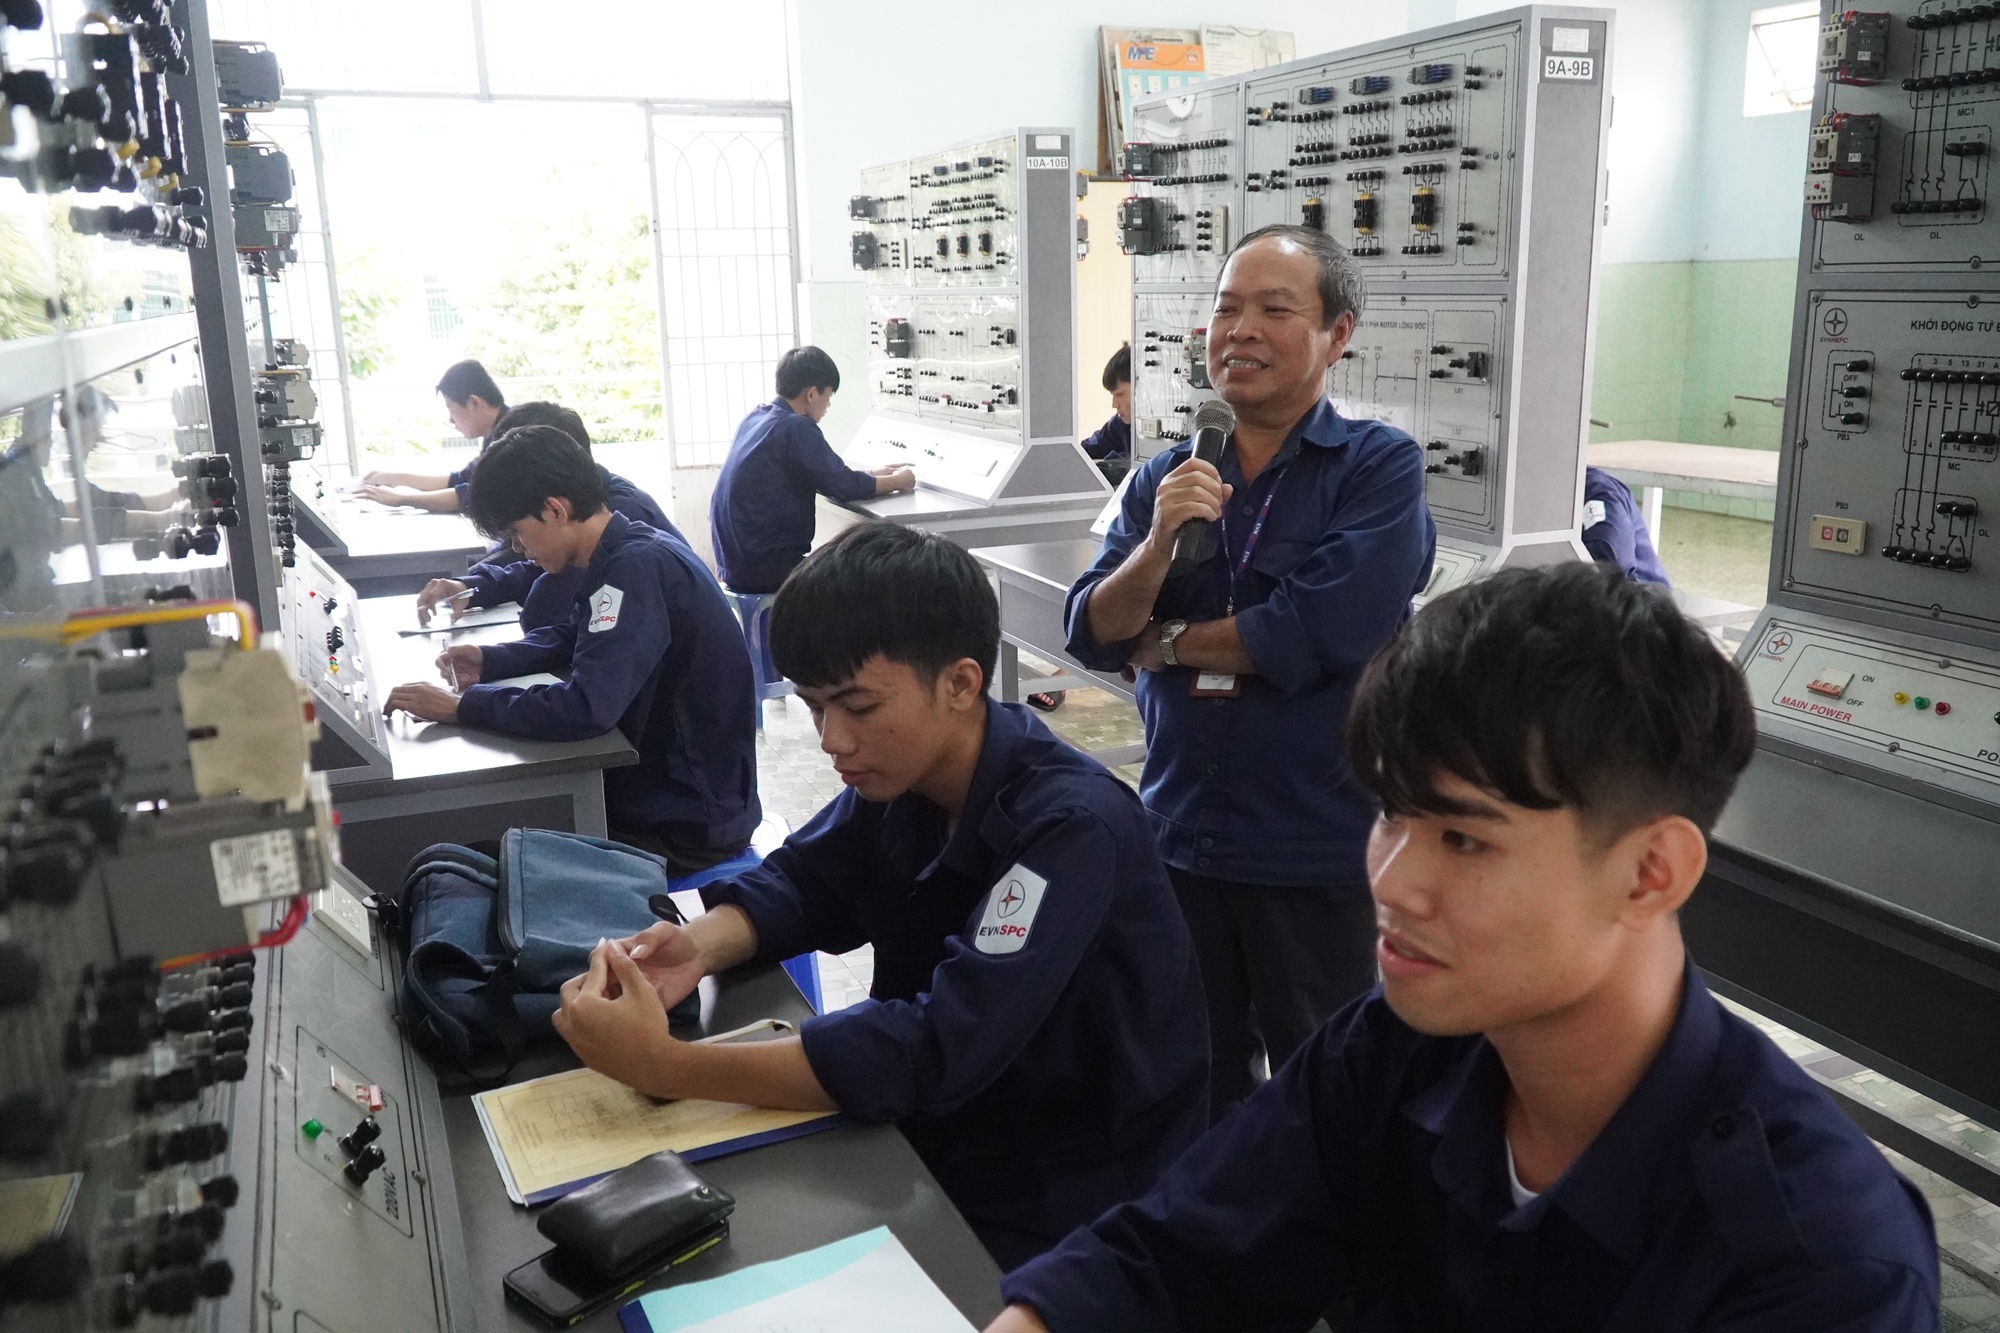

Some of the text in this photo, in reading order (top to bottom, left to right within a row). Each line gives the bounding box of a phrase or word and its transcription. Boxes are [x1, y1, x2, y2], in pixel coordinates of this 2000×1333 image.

[1547, 59, 1591, 76] 9A-9B
[1956, 107, 1975, 117] MC1
[1027, 158, 1068, 168] 10A-10B
[1854, 233, 1865, 241] OL
[1929, 231, 1942, 240] OL
[1843, 374, 1858, 382] OFF
[1844, 400, 1854, 408] ON
[1947, 462, 1961, 471] MC
[1835, 501, 1849, 510] PB3
[1978, 528, 1990, 538] OL
[1861, 674, 1876, 683] ON
[1846, 698, 1865, 708] OFF
[1779, 696, 1853, 722] MAIN POWER
[1976, 748, 2000, 764] PO
[978, 924, 1028, 938] EVNSPC
